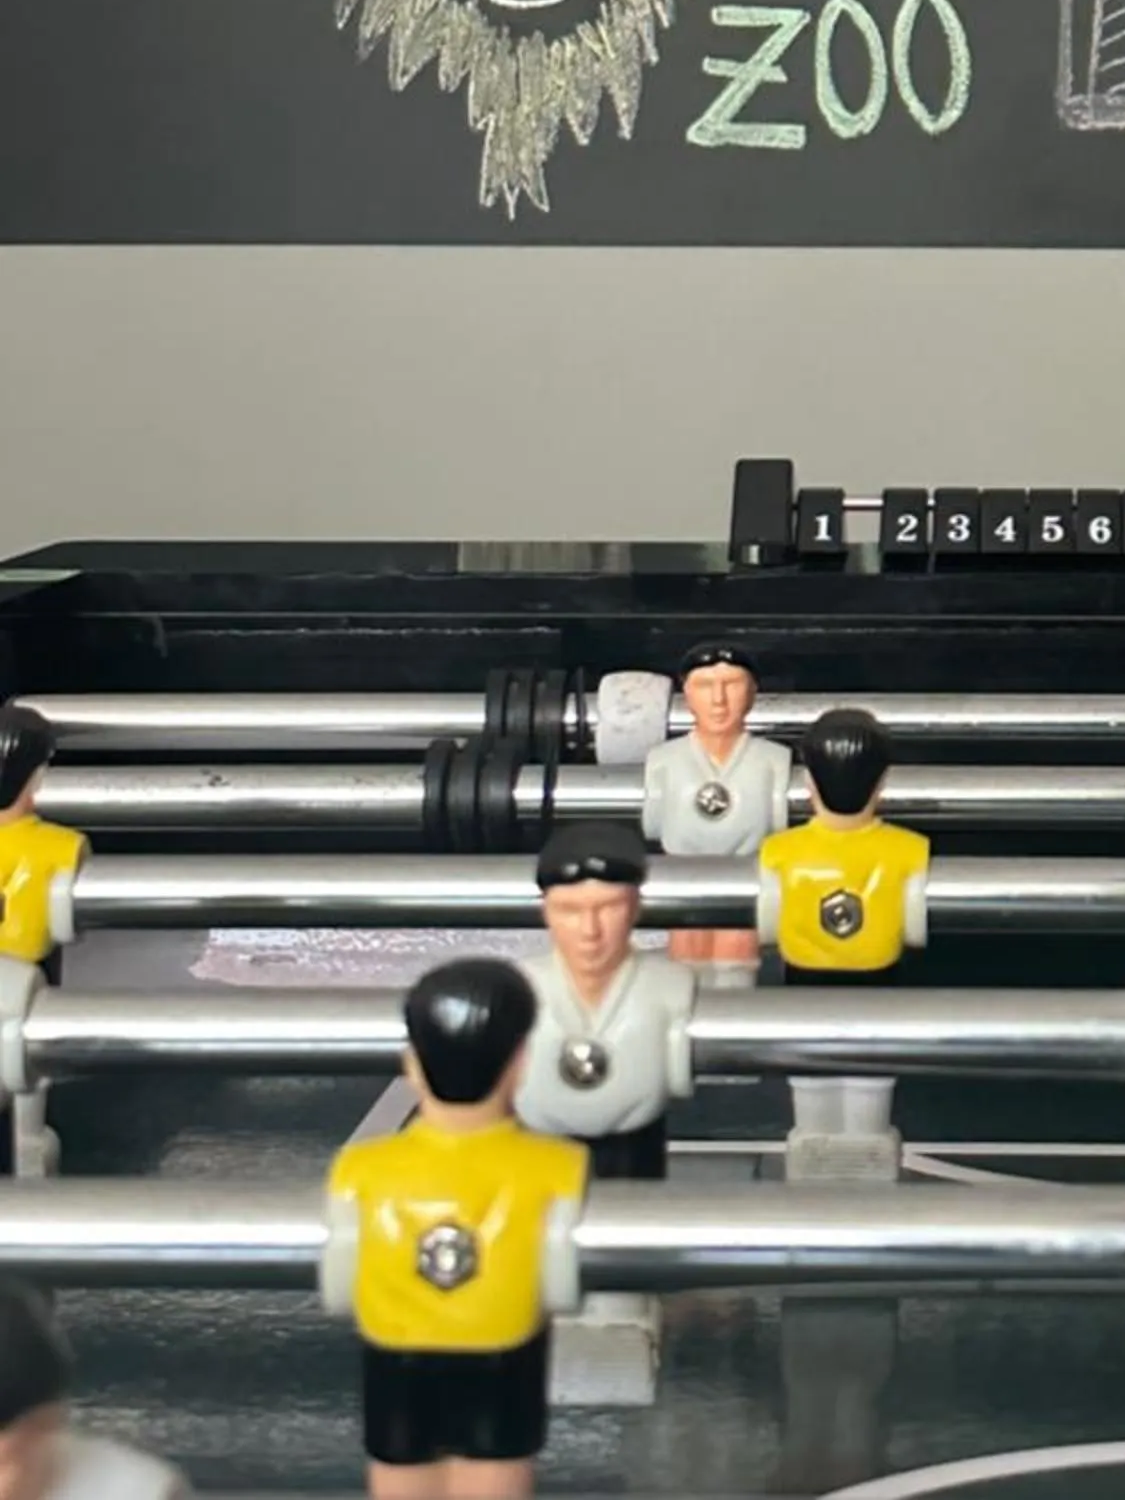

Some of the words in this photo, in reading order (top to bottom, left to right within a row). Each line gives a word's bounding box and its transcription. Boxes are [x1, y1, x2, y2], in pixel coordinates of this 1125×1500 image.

[812, 514, 834, 542] 1
[897, 514, 919, 542] 2
[947, 514, 972, 542] 3
[994, 514, 1018, 542] 4
[1041, 514, 1066, 542] 5
[1088, 514, 1114, 542] 6
